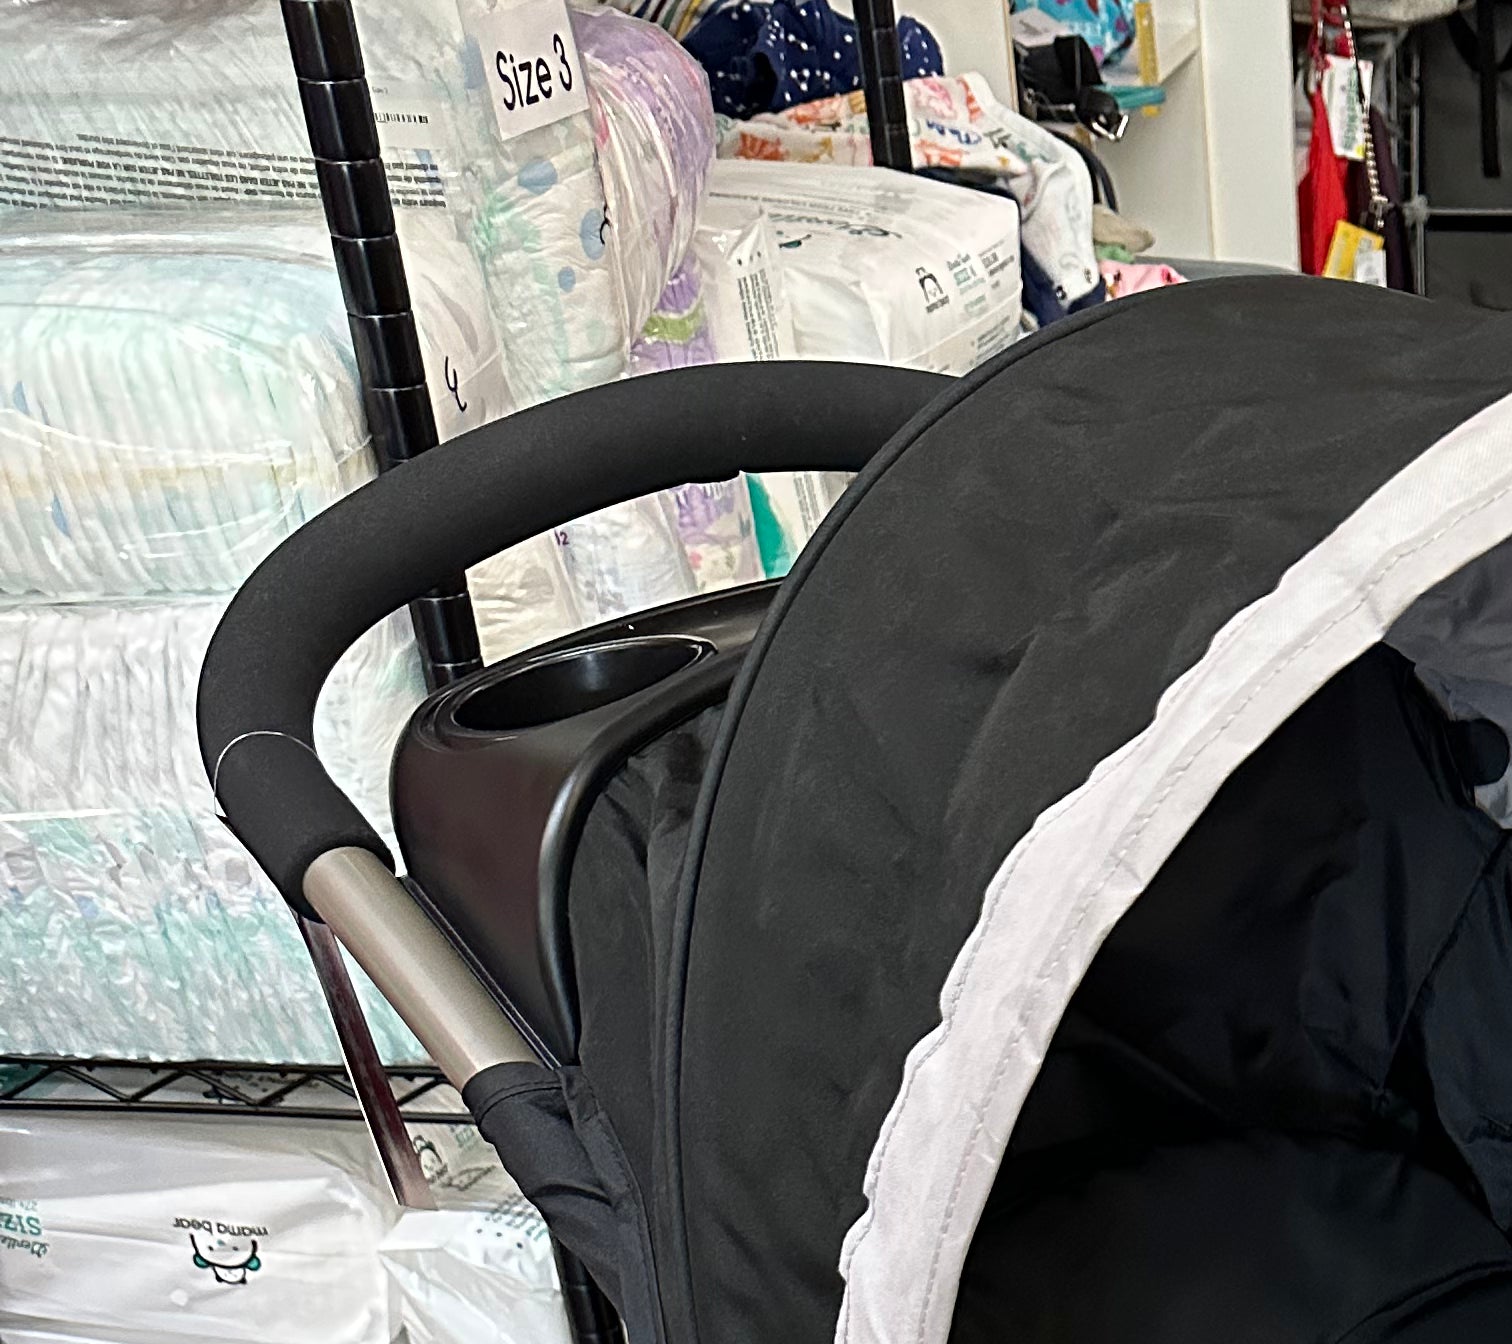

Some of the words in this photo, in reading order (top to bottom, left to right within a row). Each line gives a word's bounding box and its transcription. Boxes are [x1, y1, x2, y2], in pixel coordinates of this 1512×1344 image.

[496, 51, 552, 111] Size
[553, 34, 572, 91] 3
[0, 1212, 41, 1237] SIZ
[172, 1217, 213, 1237] bear
[216, 1222, 269, 1239] mama
